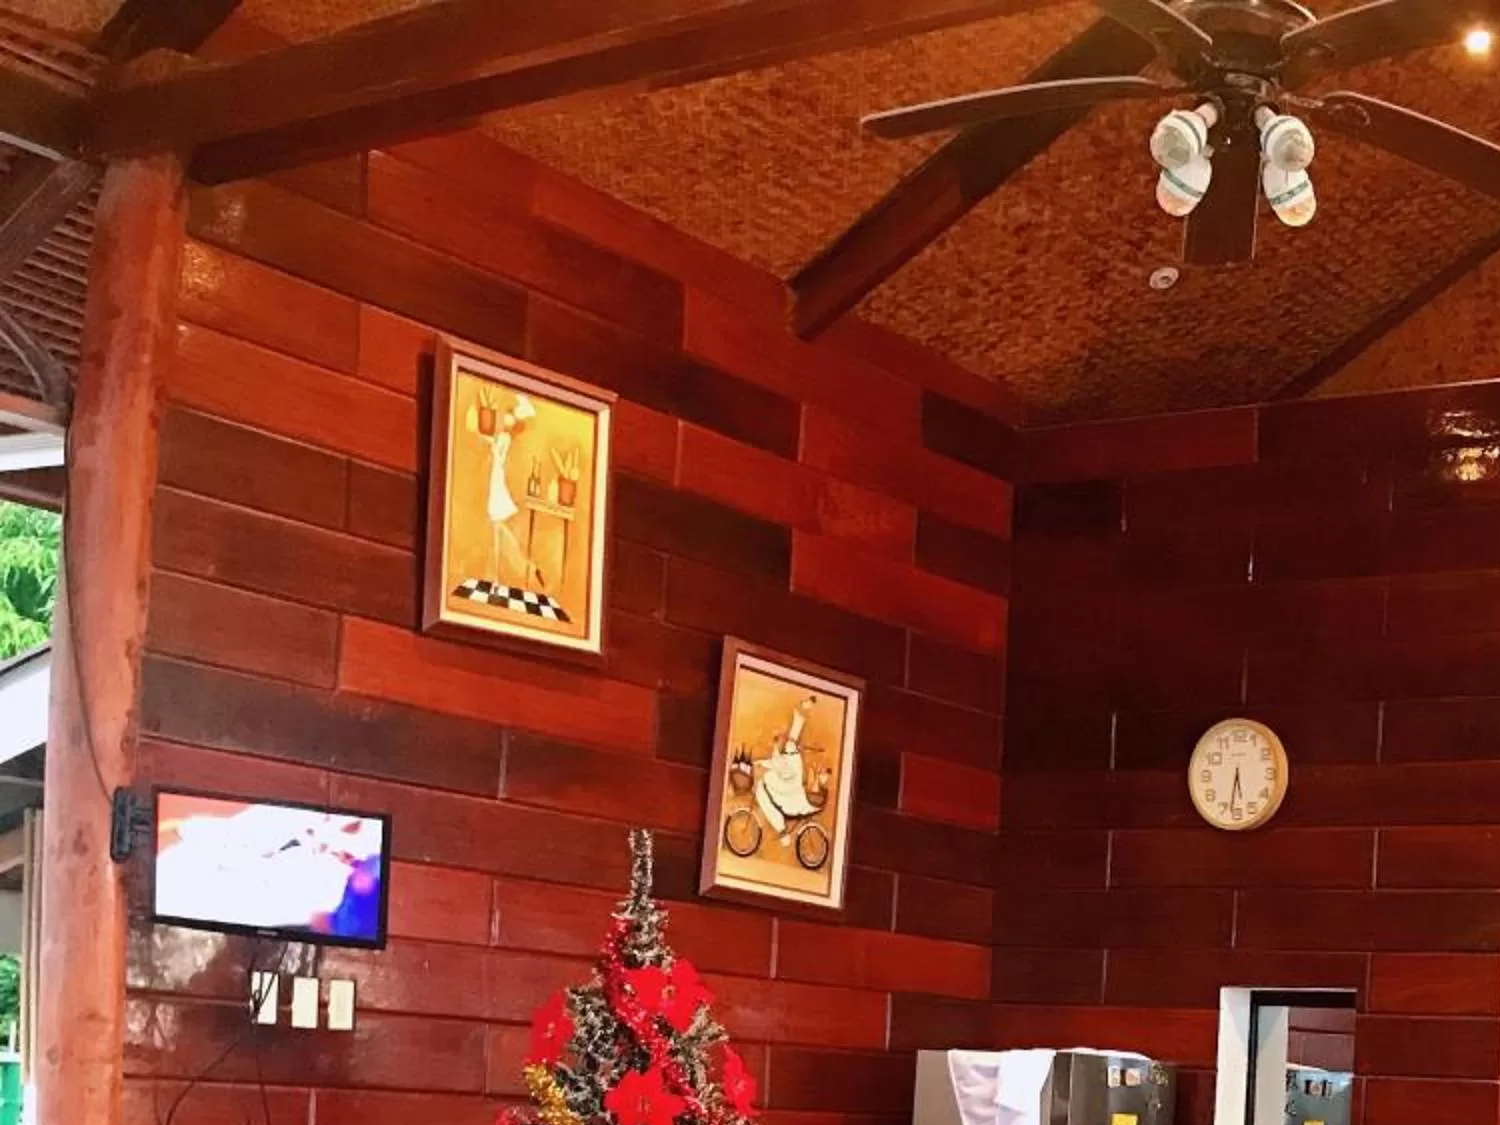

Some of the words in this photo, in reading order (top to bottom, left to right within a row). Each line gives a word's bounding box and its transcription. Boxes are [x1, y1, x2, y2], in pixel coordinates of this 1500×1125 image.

[1207, 751, 1222, 765] 10
[1201, 769, 1212, 783] 9
[1258, 786, 1269, 799] 4
